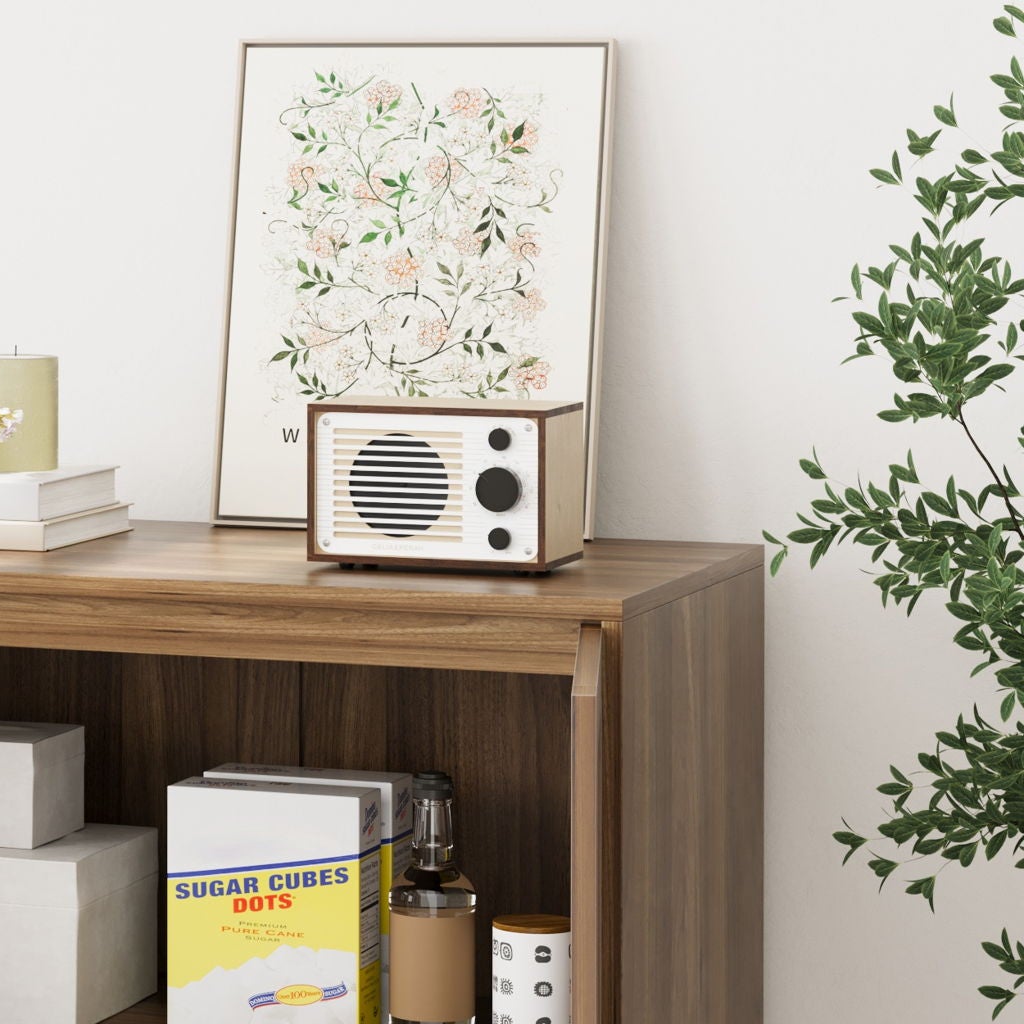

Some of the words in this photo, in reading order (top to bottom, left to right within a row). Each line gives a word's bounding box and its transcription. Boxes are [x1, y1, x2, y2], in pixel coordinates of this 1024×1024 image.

[175, 875, 260, 900] SUGAR
[268, 866, 350, 893] CUBES
[232, 893, 293, 914] DOTS
[221, 926, 260, 936] PURE
[265, 930, 305, 939] CANE
